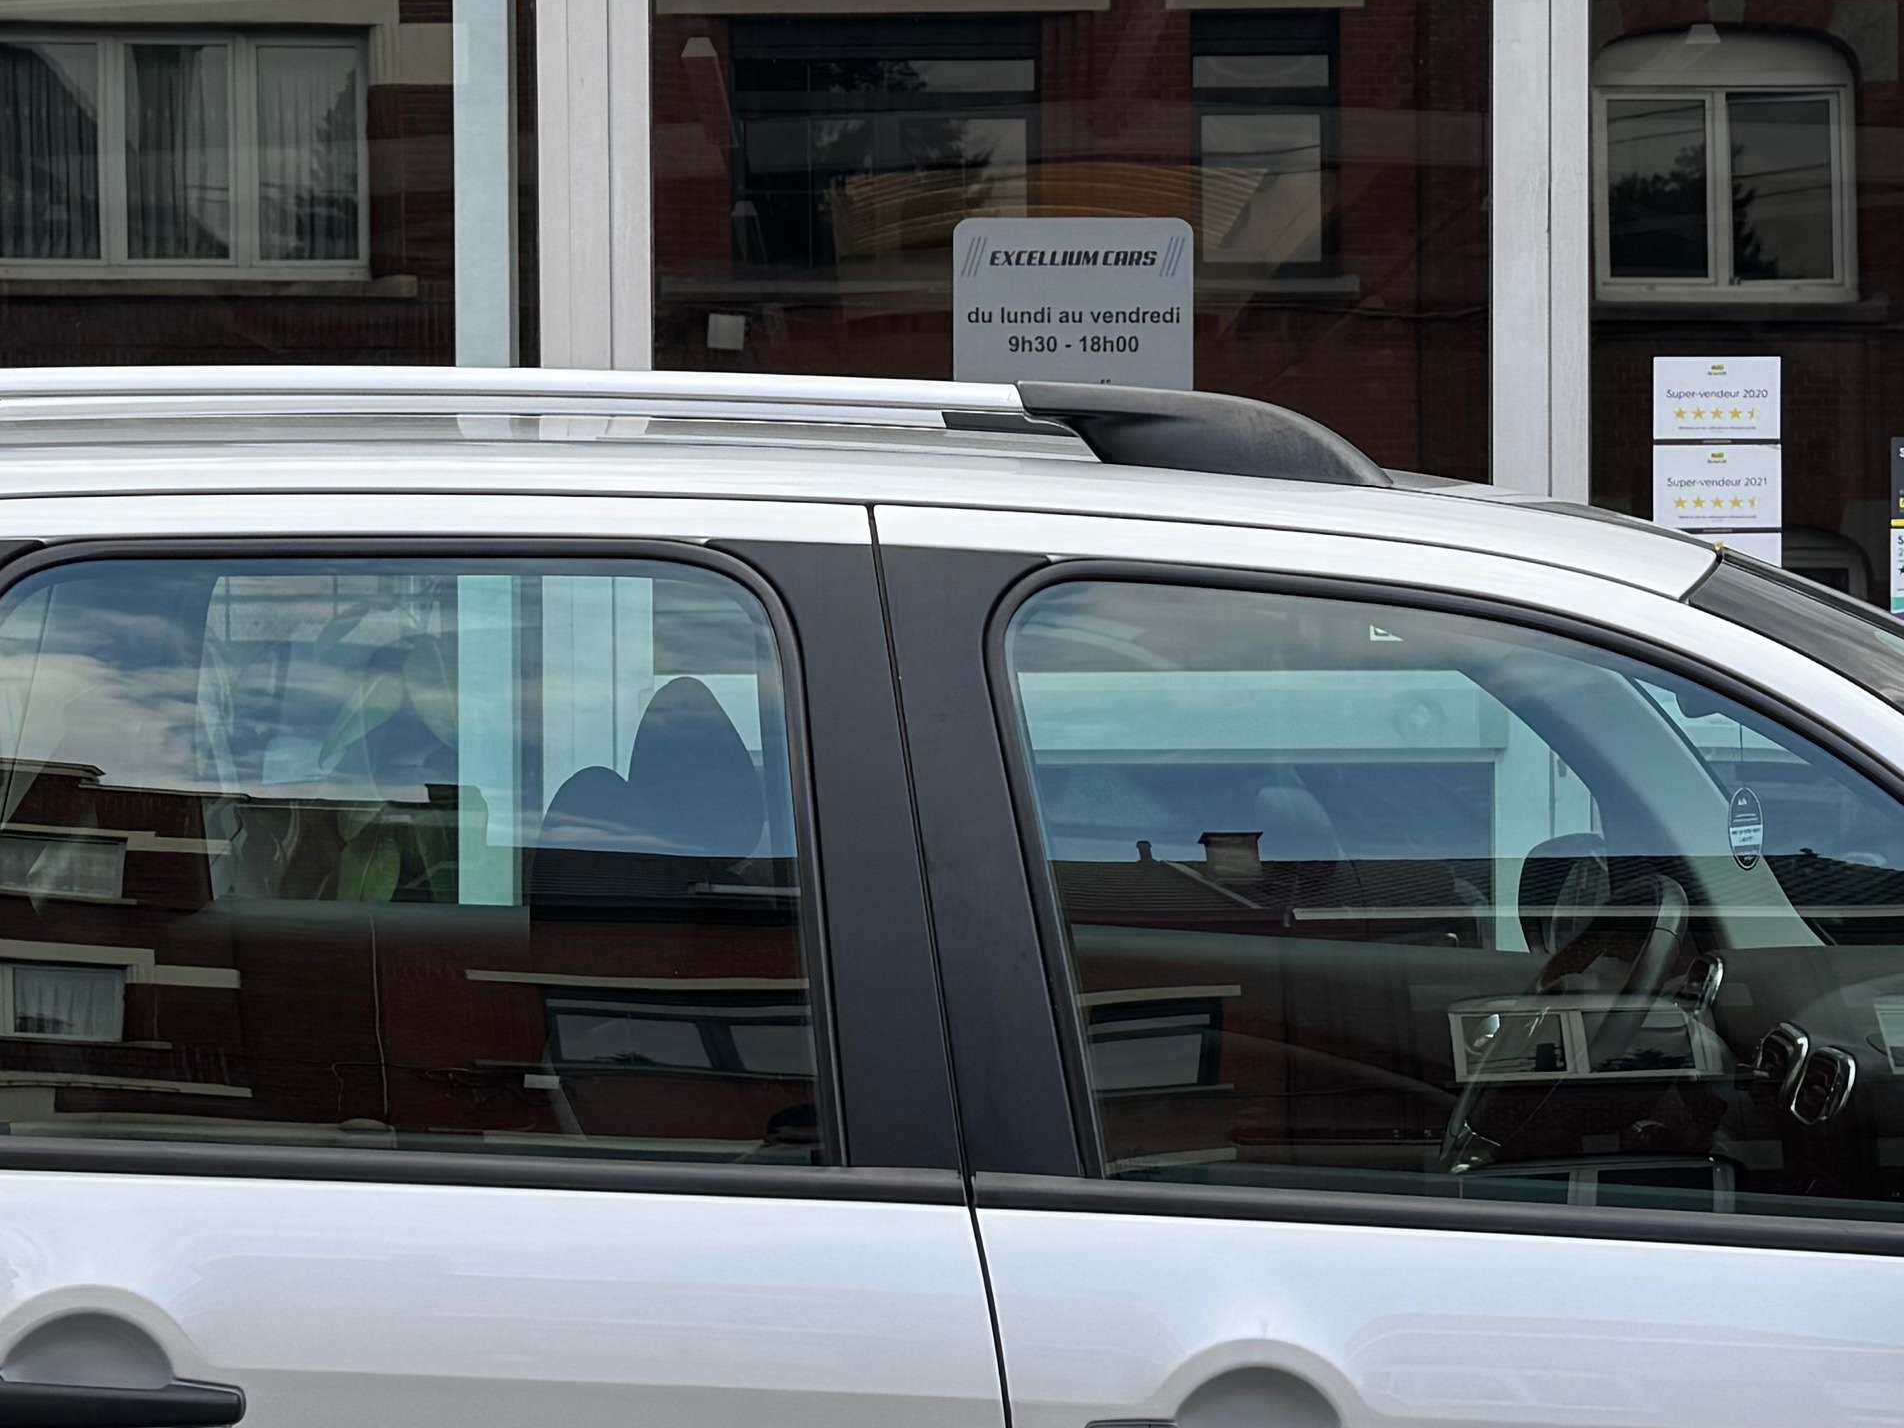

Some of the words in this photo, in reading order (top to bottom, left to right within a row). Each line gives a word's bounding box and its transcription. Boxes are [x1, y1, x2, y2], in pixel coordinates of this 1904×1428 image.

[990, 250, 1099, 266] EXCELLIUM
[1103, 250, 1157, 266] CARS
[967, 307, 992, 324] du
[1000, 307, 1051, 324] lundi
[1059, 310, 1081, 324] au
[1090, 307, 1181, 324] vendredi
[1008, 336, 1058, 353] 9h30
[1079, 336, 1139, 353] 18h00
[1666, 389, 1740, 400] Super-vendeur
[1667, 477, 1741, 487] Super-vendeur
[1743, 477, 1767, 486] 2021
